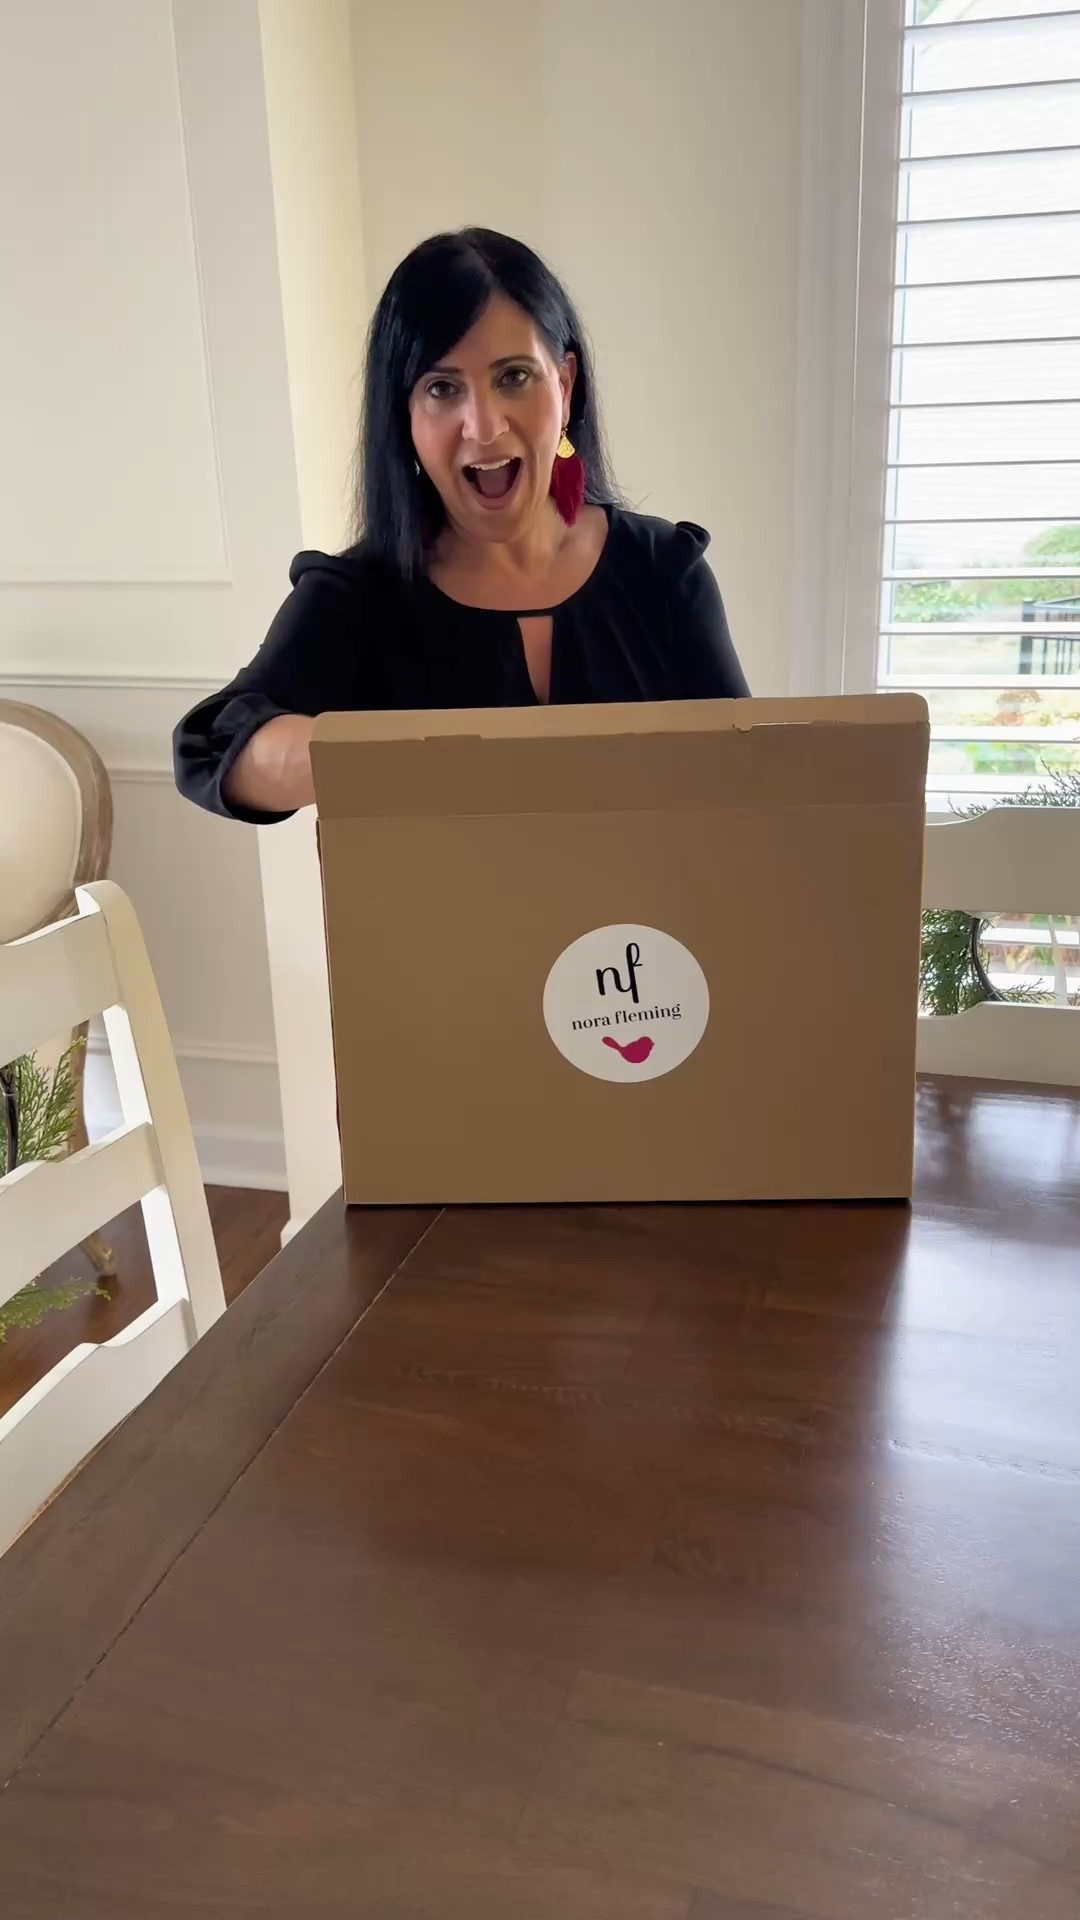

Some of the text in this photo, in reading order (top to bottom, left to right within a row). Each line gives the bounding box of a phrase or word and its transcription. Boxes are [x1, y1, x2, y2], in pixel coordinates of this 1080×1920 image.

[595, 942, 643, 1004] nf
[572, 1003, 682, 1030] nora fleming
